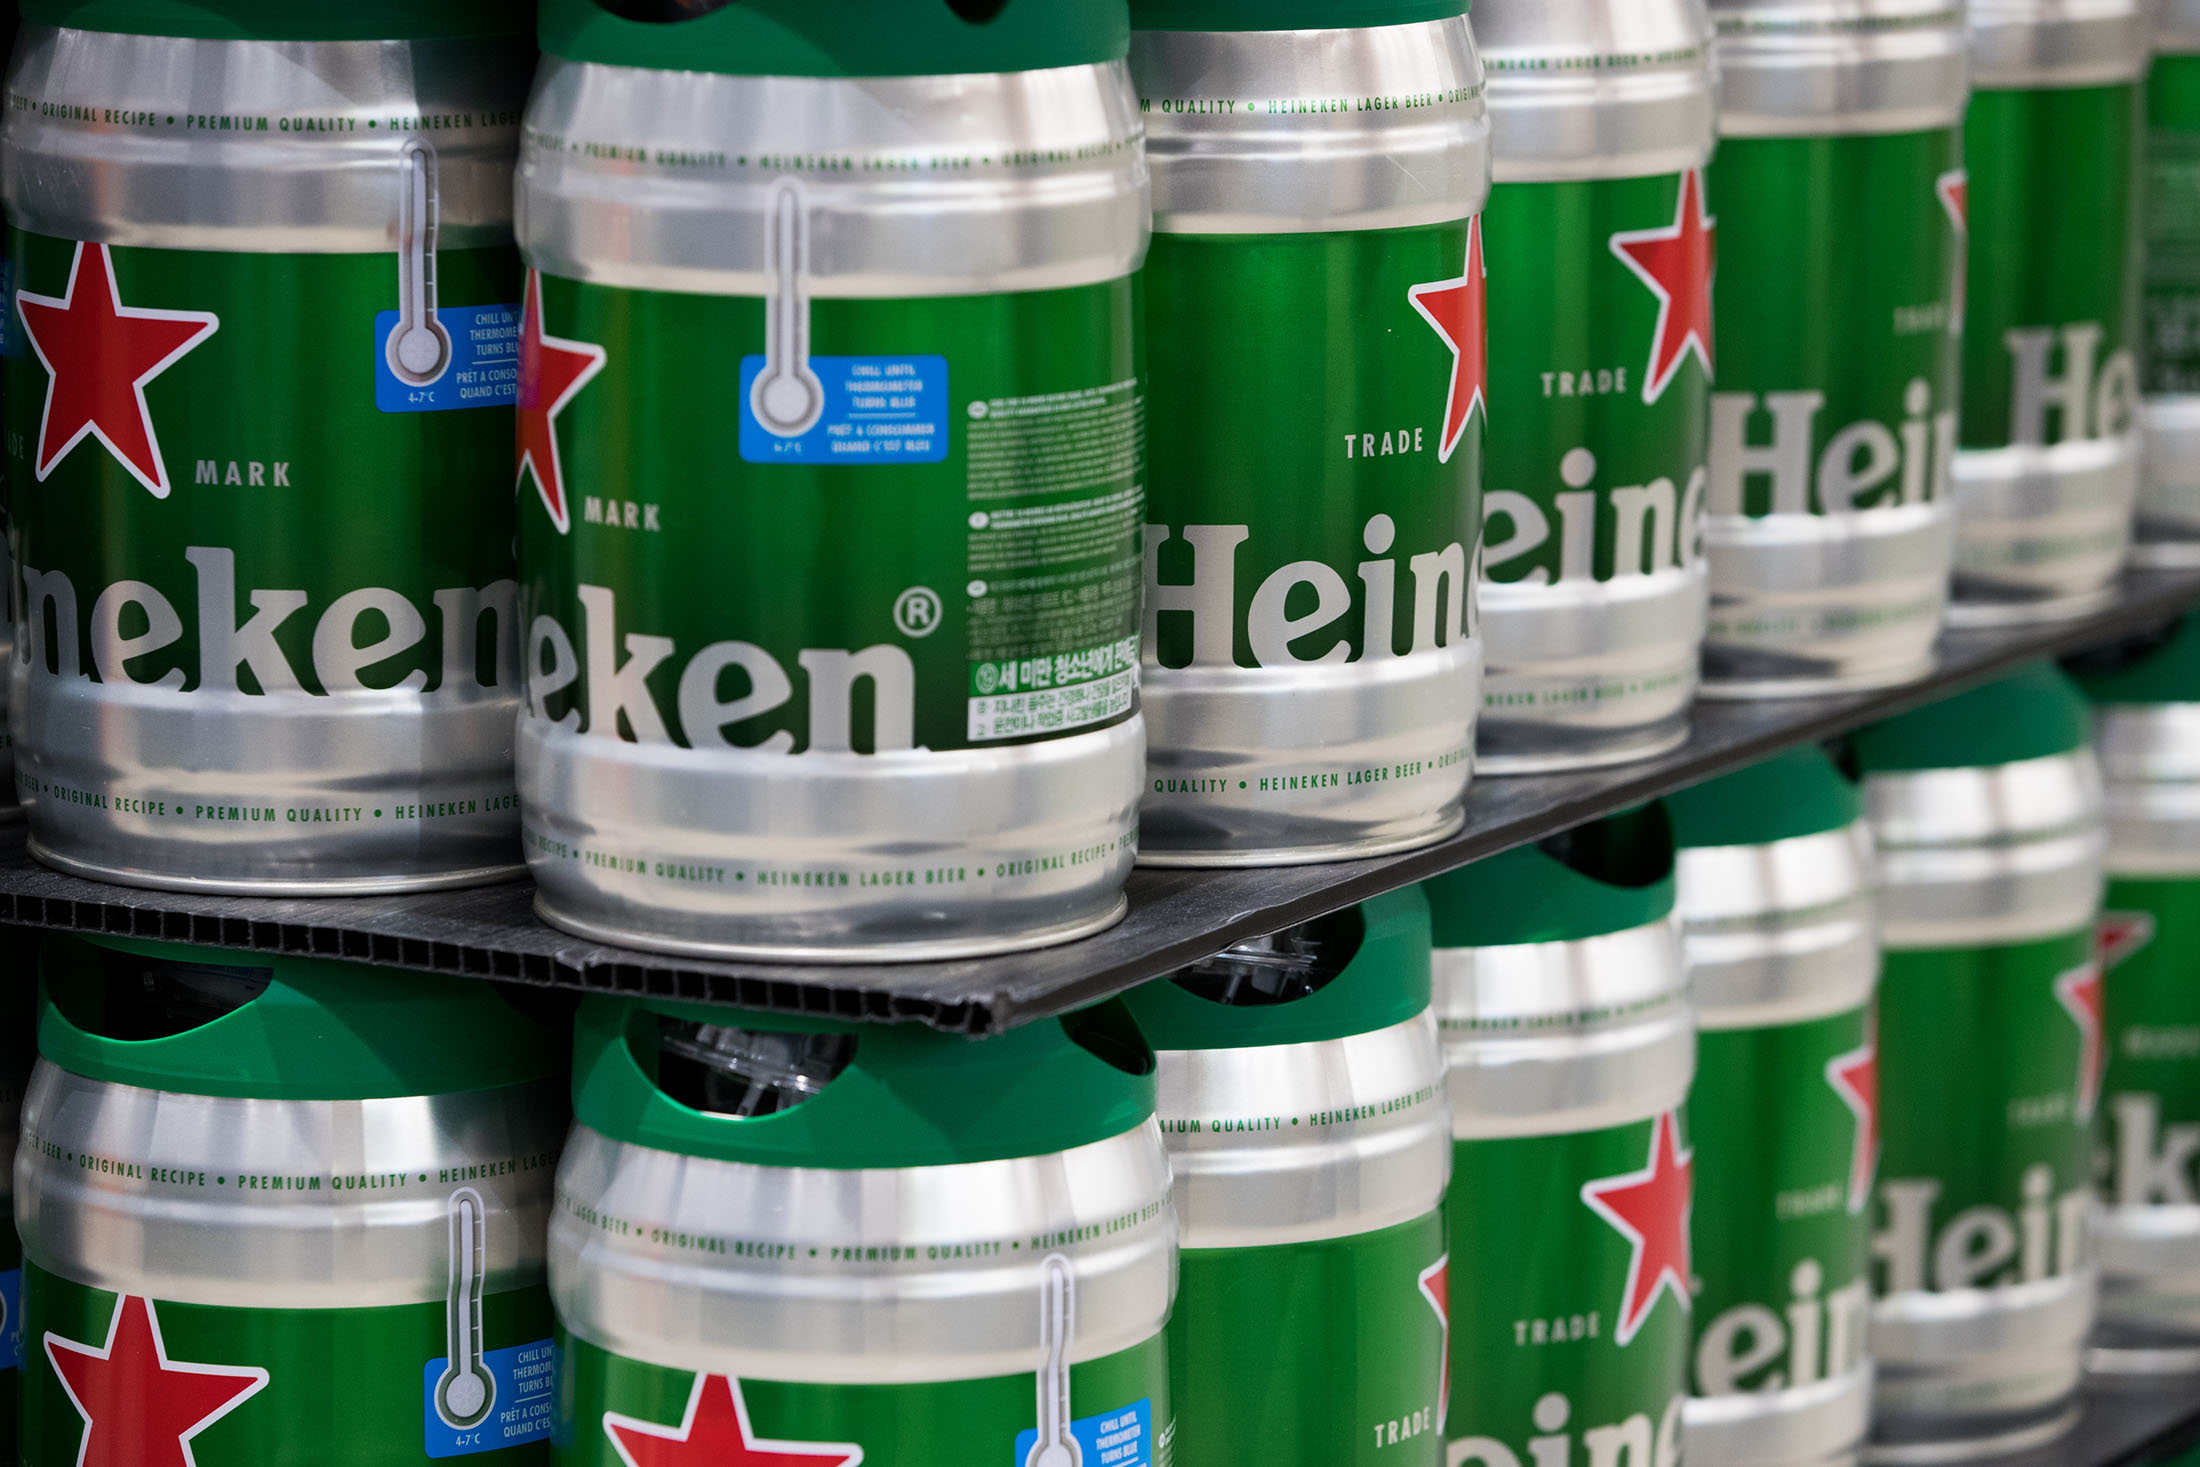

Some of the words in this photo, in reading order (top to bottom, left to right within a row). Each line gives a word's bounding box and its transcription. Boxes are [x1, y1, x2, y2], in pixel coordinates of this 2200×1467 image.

[42, 101, 97, 122] ORIGINAL
[105, 109, 155, 127] RECIPE
[187, 115, 268, 131] PREMIUM
[279, 117, 355, 131] QUALITY
[390, 113, 472, 131] HEINEKEN
[1162, 99, 1236, 114] QUALITY
[1269, 98, 1348, 114] HEINEKEN
[1357, 96, 1399, 111] LAGER
[1404, 93, 1432, 109] BEER
[475, 312, 499, 325] CHILL
[476, 343, 503, 356] TURNS
[460, 387, 492, 399] QUAND
[1540, 367, 1627, 397] TRADE
[1345, 428, 1423, 459] TRADE
[195, 459, 292, 490] MARK
[584, 495, 661, 532] MARK
[1020, 657, 1051, 689] 미만
[1154, 779, 1227, 793] QUALITY
[1260, 773, 1338, 792] HEINEKEN
[1347, 766, 1389, 785] LAGER
[1396, 761, 1421, 779] BEER
[25, 774, 40, 792] BEER
[54, 785, 108, 809] ORIGINAL
[115, 797, 165, 816] RECIPE
[196, 806, 276, 822] PREMIUM
[287, 808, 362, 822] QUALITY
[395, 799, 476, 819] HEINEKEN
[995, 854, 1066, 878] ORIGINAL
[1212, 1117, 1281, 1133] QUALITY
[1310, 1103, 1376, 1128] HEINEKEN
[1381, 1094, 1413, 1116] LAGER
[43, 1141, 61, 1160] BEER
[80, 1153, 142, 1180] ORIGINAL
[152, 1167, 205, 1186] RECIPE
[238, 1175, 320, 1191] PREMIUM
[332, 1172, 407, 1190] QUALITY
[440, 1159, 516, 1184] HEINEKEN
[518, 1350, 539, 1364] CHILL
[519, 1380, 543, 1394] TURNS
[503, 1422, 533, 1438] QUAND
[1374, 1406, 1430, 1449] TRADE
